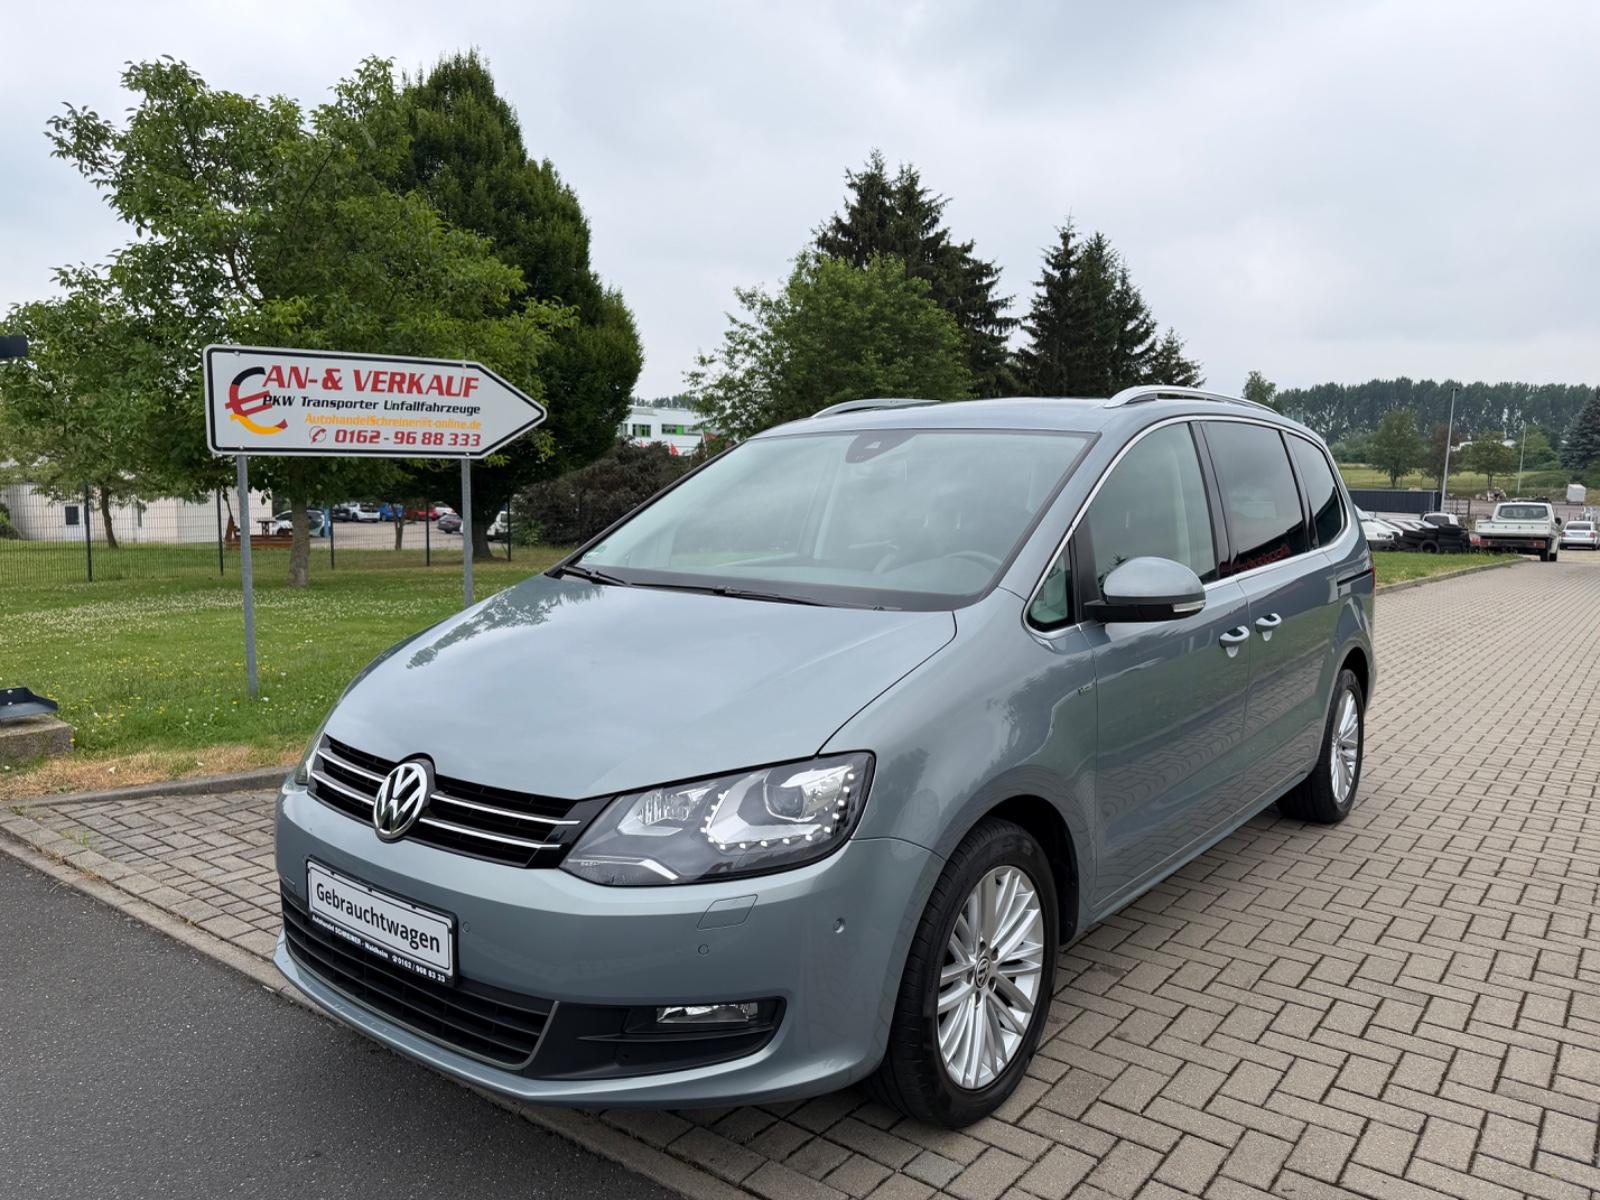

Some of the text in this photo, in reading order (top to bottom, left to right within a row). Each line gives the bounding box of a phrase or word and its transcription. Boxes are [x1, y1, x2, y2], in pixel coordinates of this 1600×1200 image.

[321, 368, 344, 391] &
[353, 369, 480, 398] VERKAUF
[262, 394, 481, 417] PKW Transporter Unfallfahrzeuge
[334, 428, 381, 444] 0162
[393, 431, 417, 445] 96
[421, 432, 445, 446] 88
[448, 433, 482, 447] 333
[316, 882, 441, 954] Gebrauchtwagen
